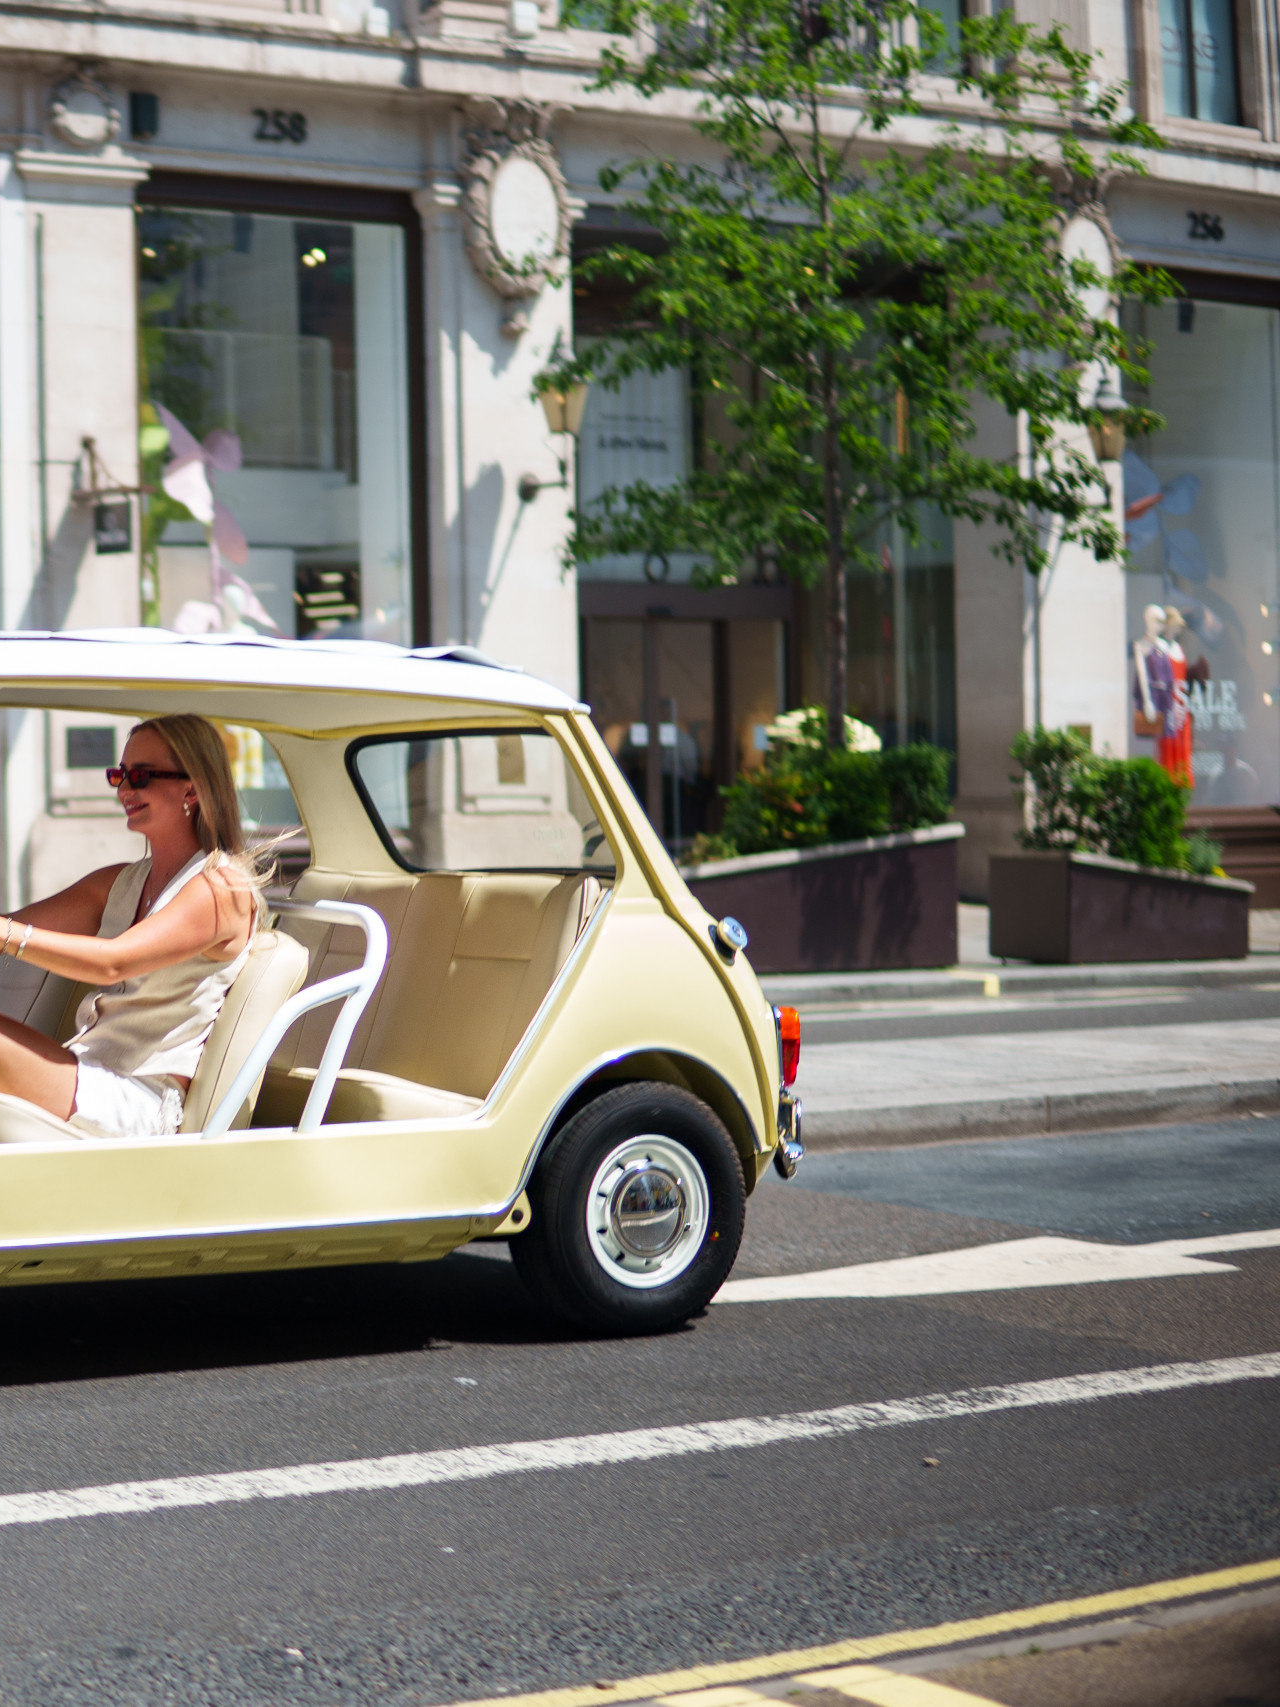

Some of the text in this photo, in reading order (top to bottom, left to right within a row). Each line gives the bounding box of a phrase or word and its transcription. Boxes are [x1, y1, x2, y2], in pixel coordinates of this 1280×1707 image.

[251, 108, 307, 144] 258
[1185, 209, 1225, 243] 256
[1172, 679, 1238, 714] SALE
